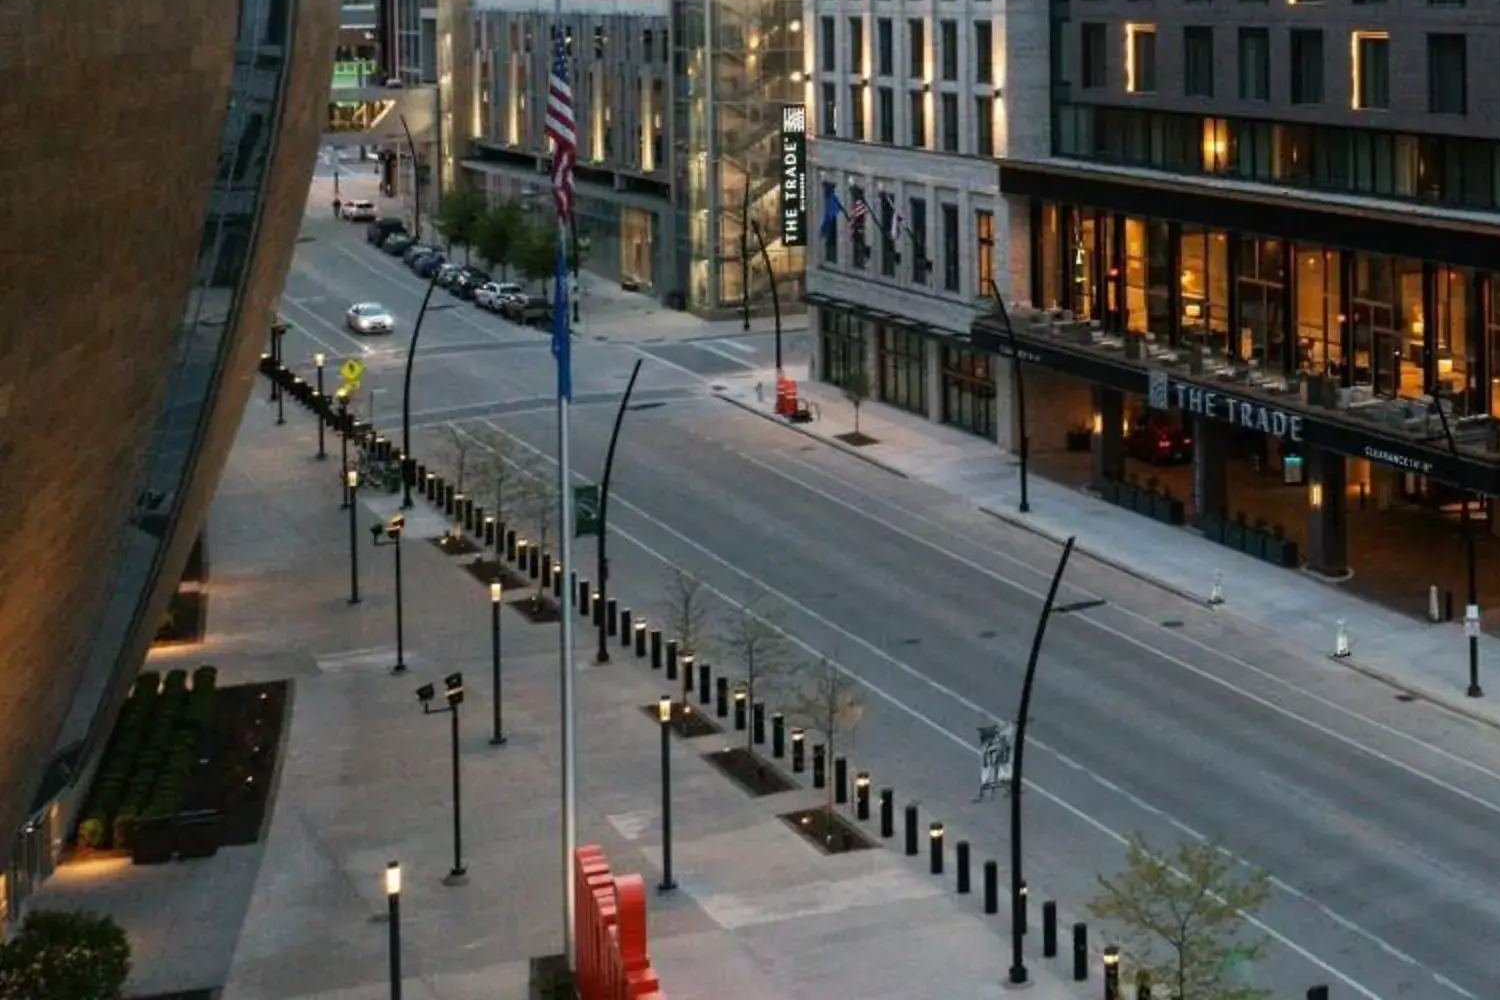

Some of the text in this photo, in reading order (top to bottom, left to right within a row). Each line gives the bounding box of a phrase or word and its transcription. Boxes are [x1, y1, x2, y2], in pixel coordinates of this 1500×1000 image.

[785, 208, 798, 243] THE
[1174, 383, 1304, 443] THE TRADE
